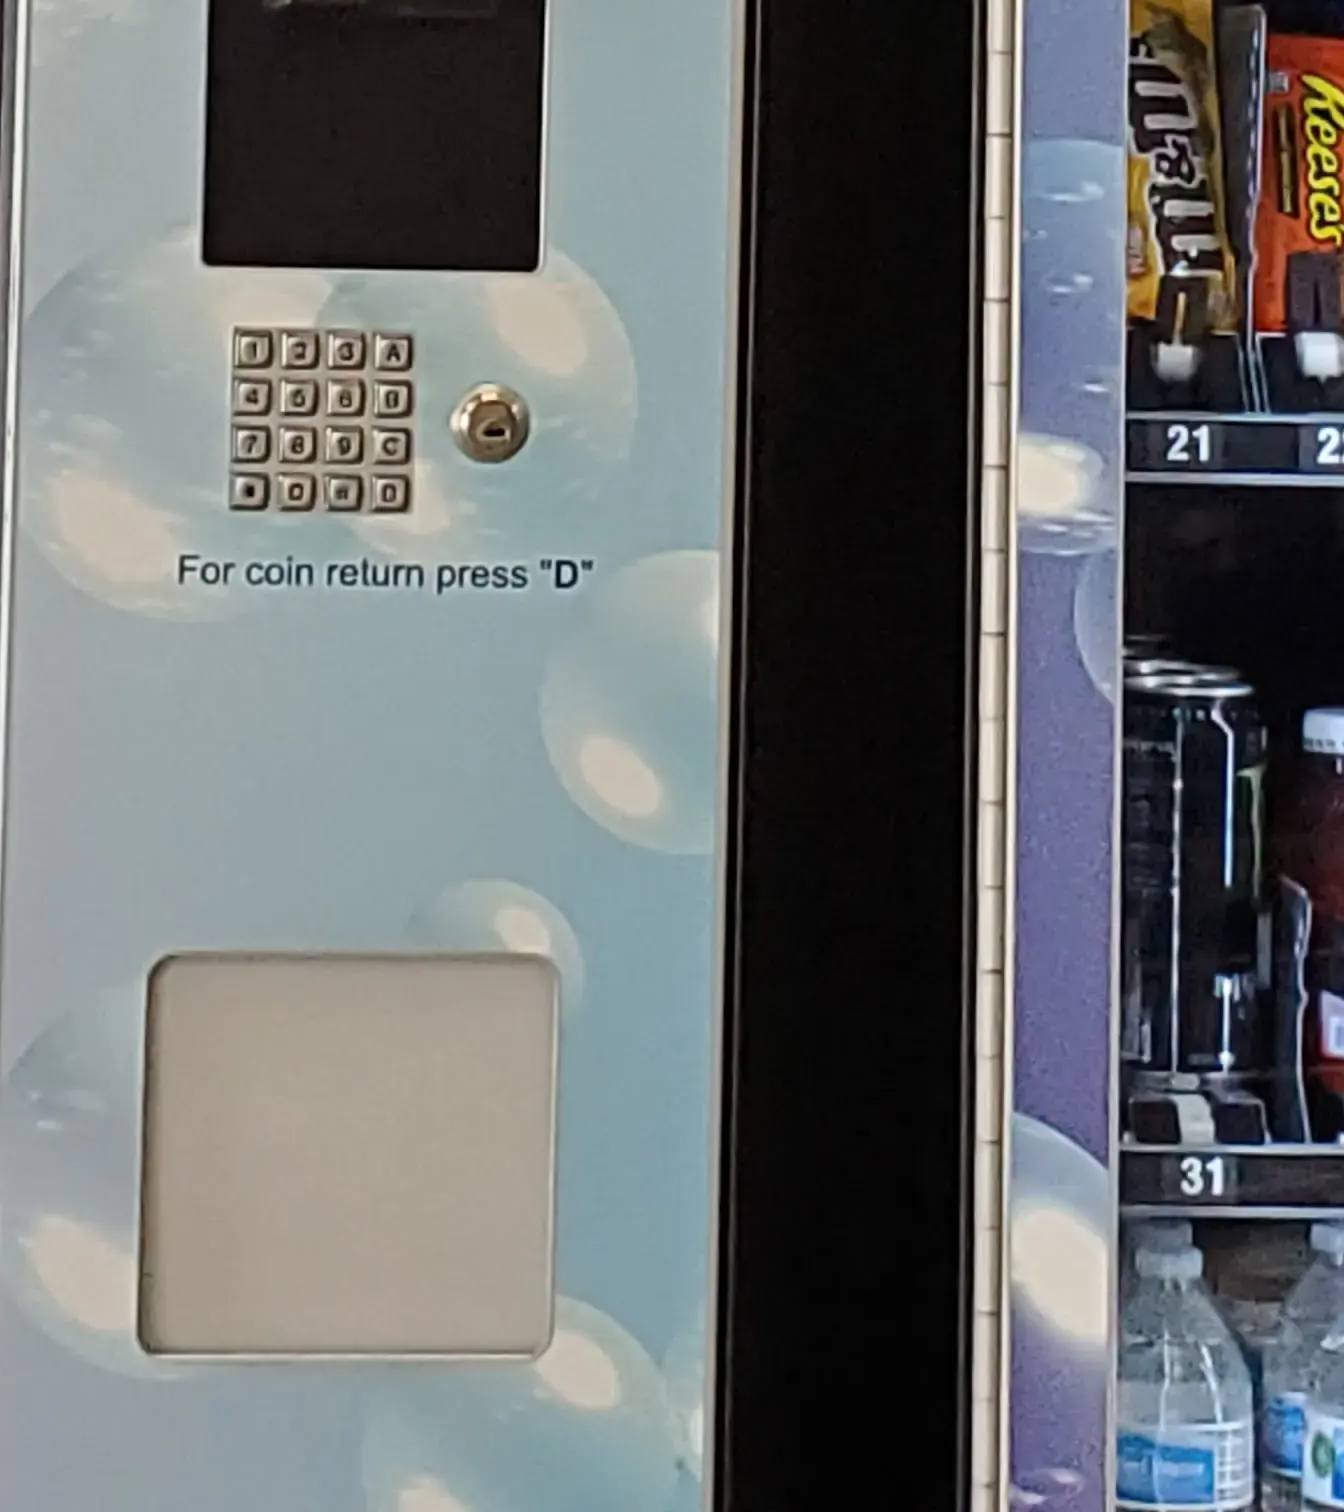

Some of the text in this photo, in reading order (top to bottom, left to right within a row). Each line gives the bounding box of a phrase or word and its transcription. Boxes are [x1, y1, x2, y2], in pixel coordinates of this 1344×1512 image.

[338, 341, 354, 361] 3
[385, 343, 402, 362] A
[245, 436, 258, 455] 7
[338, 436, 351, 456] 9
[383, 437, 399, 456] C
[1166, 425, 1212, 463] 21
[177, 555, 595, 595] For coin return press "D"
[1179, 1159, 1225, 1197] 31
